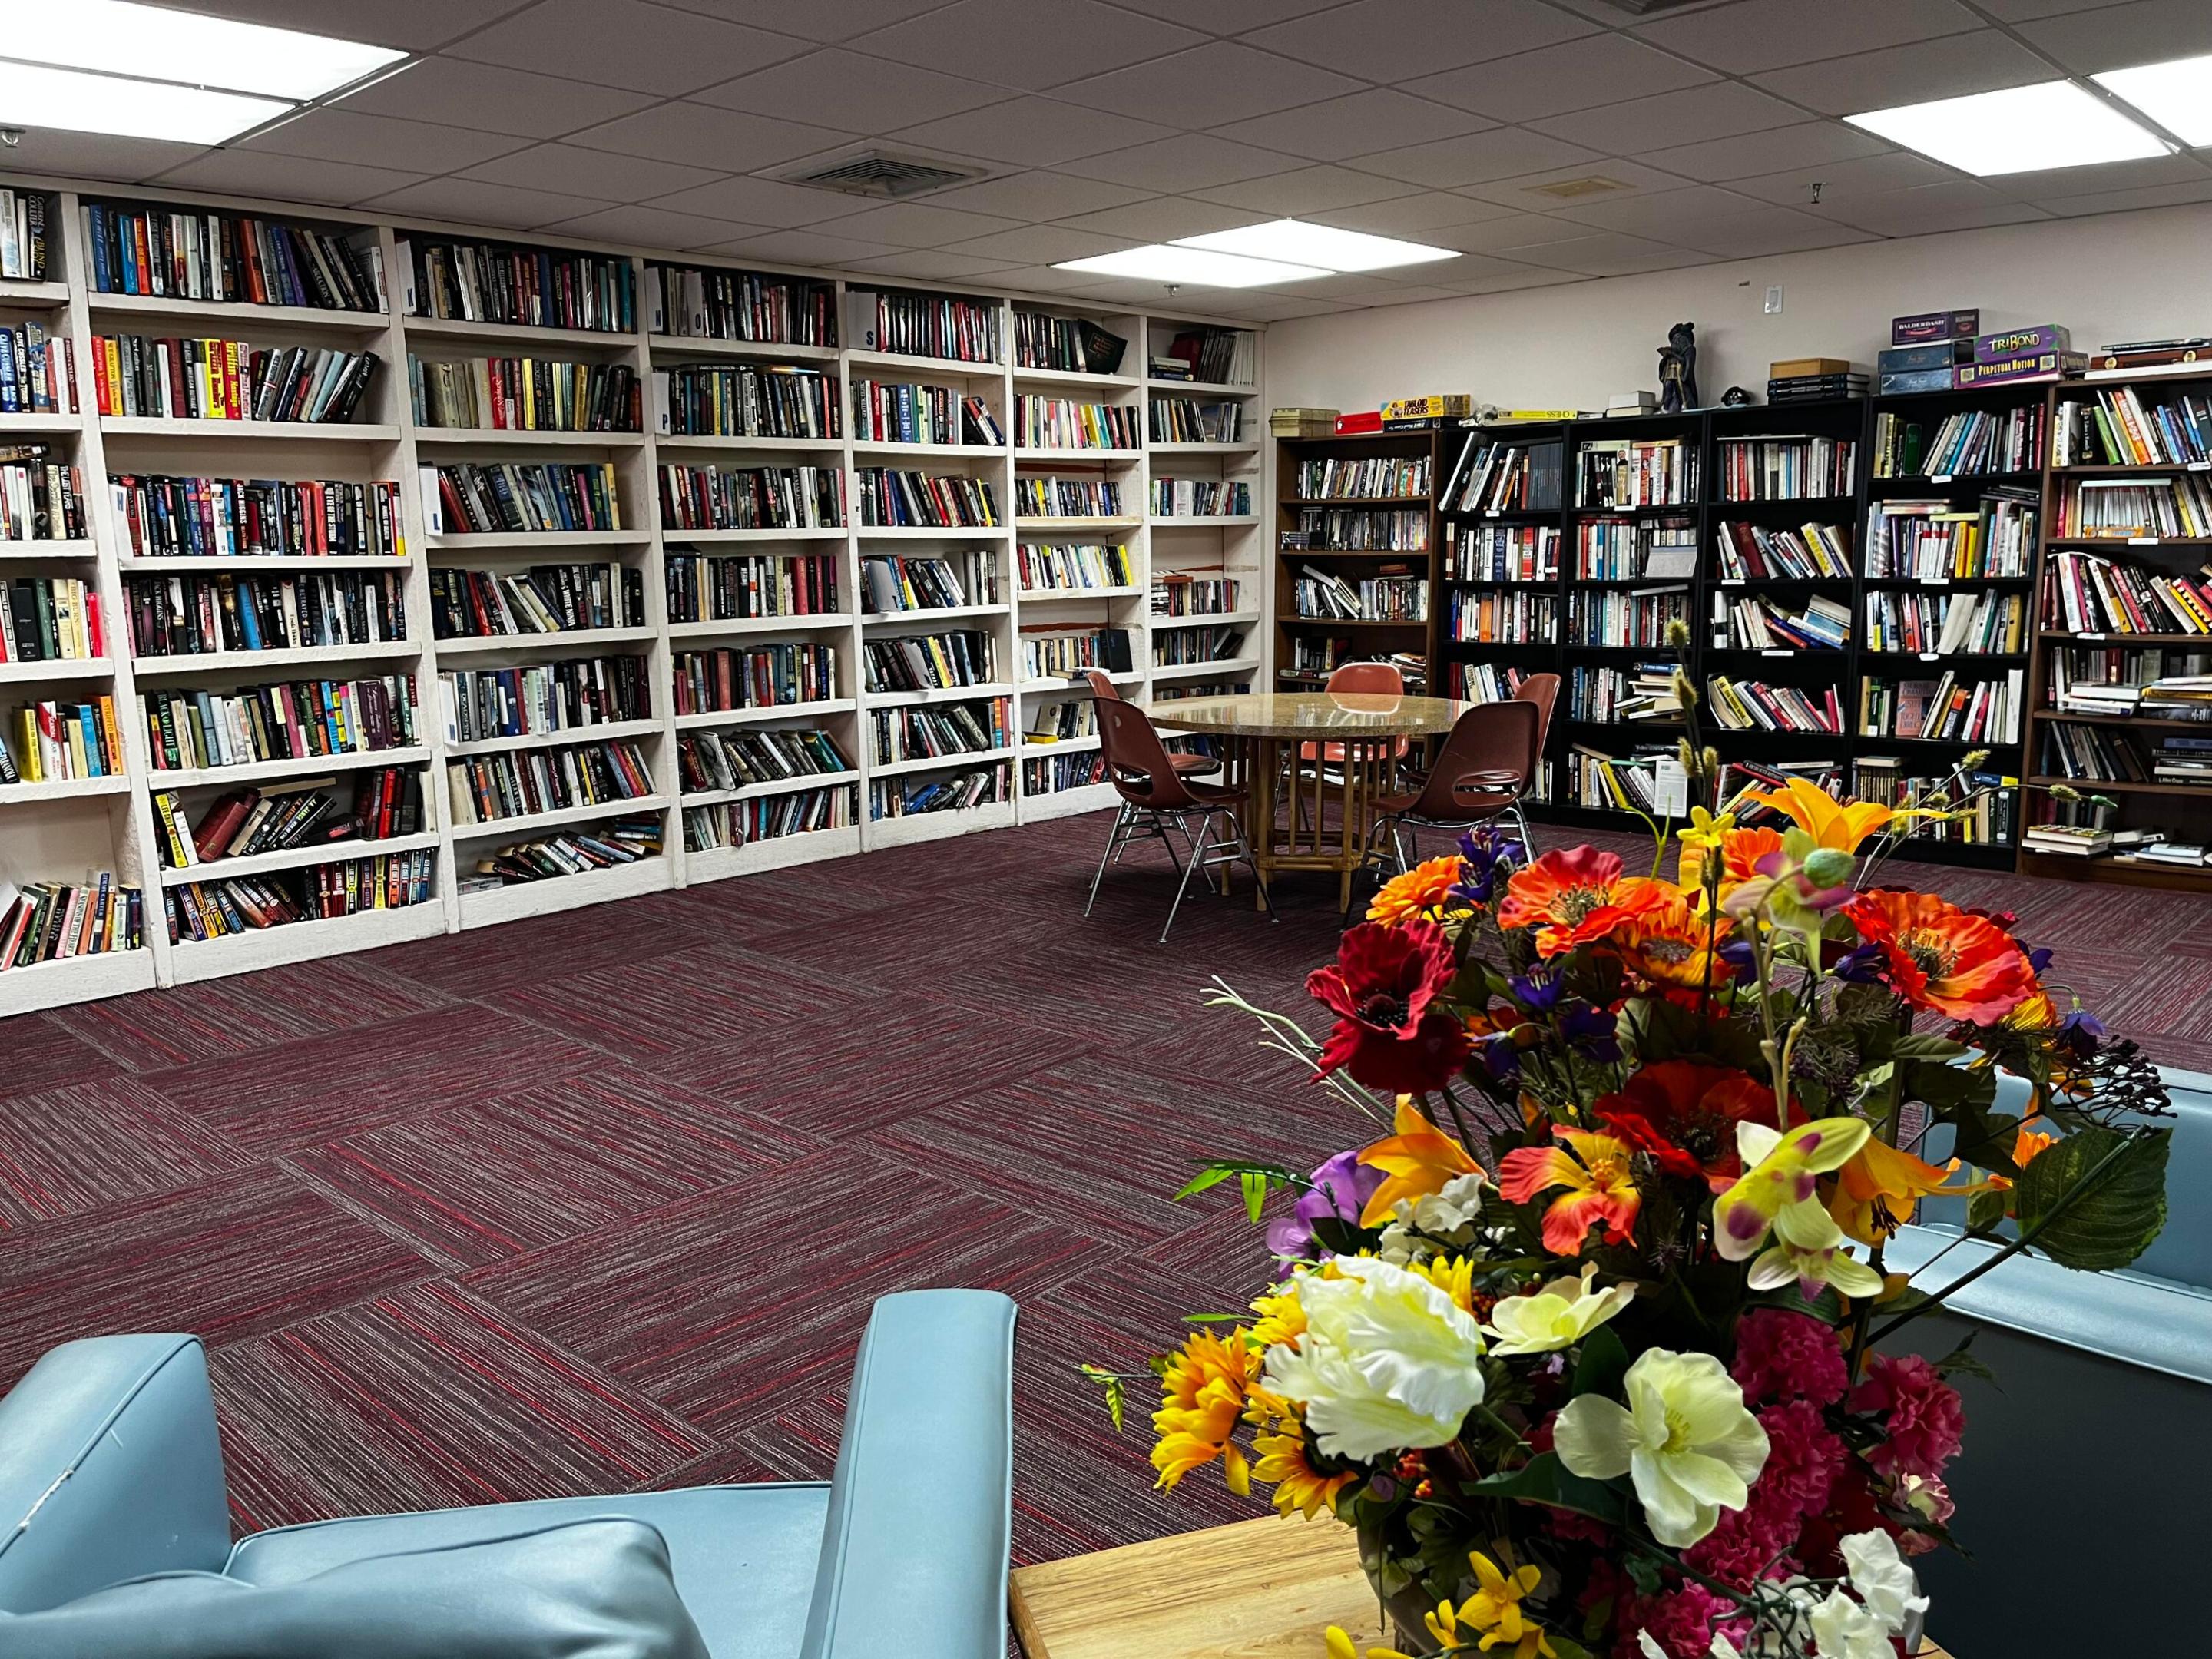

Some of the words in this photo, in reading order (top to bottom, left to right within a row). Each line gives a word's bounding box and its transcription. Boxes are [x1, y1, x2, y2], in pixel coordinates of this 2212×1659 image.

[1899, 320, 1945, 330] BALDERDASH
[866, 330, 874, 346] S
[18, 348, 26, 373] CUSSLER
[1979, 361, 2012, 376] PERPETUAL
[2012, 358, 2035, 372] MOTION
[59, 465, 68, 477] THE
[61, 476, 71, 492] LOST
[235, 483, 244, 498] JACK
[62, 491, 73, 509] YEARS
[237, 499, 247, 524] HIGGINS
[154, 595, 164, 620] HIGGINS
[562, 589, 572, 608] WHITE
[565, 608, 575, 626] NINJA
[157, 694, 170, 717] BLACK
[162, 724, 175, 747] LIGHT
[509, 776, 518, 796] CLEAN
[161, 804, 169, 813] LEE
[295, 805, 310, 822] JANCE
[164, 813, 174, 827] CHILD
[98, 873, 108, 892] JIMMY
[96, 893, 106, 916] CARTER
